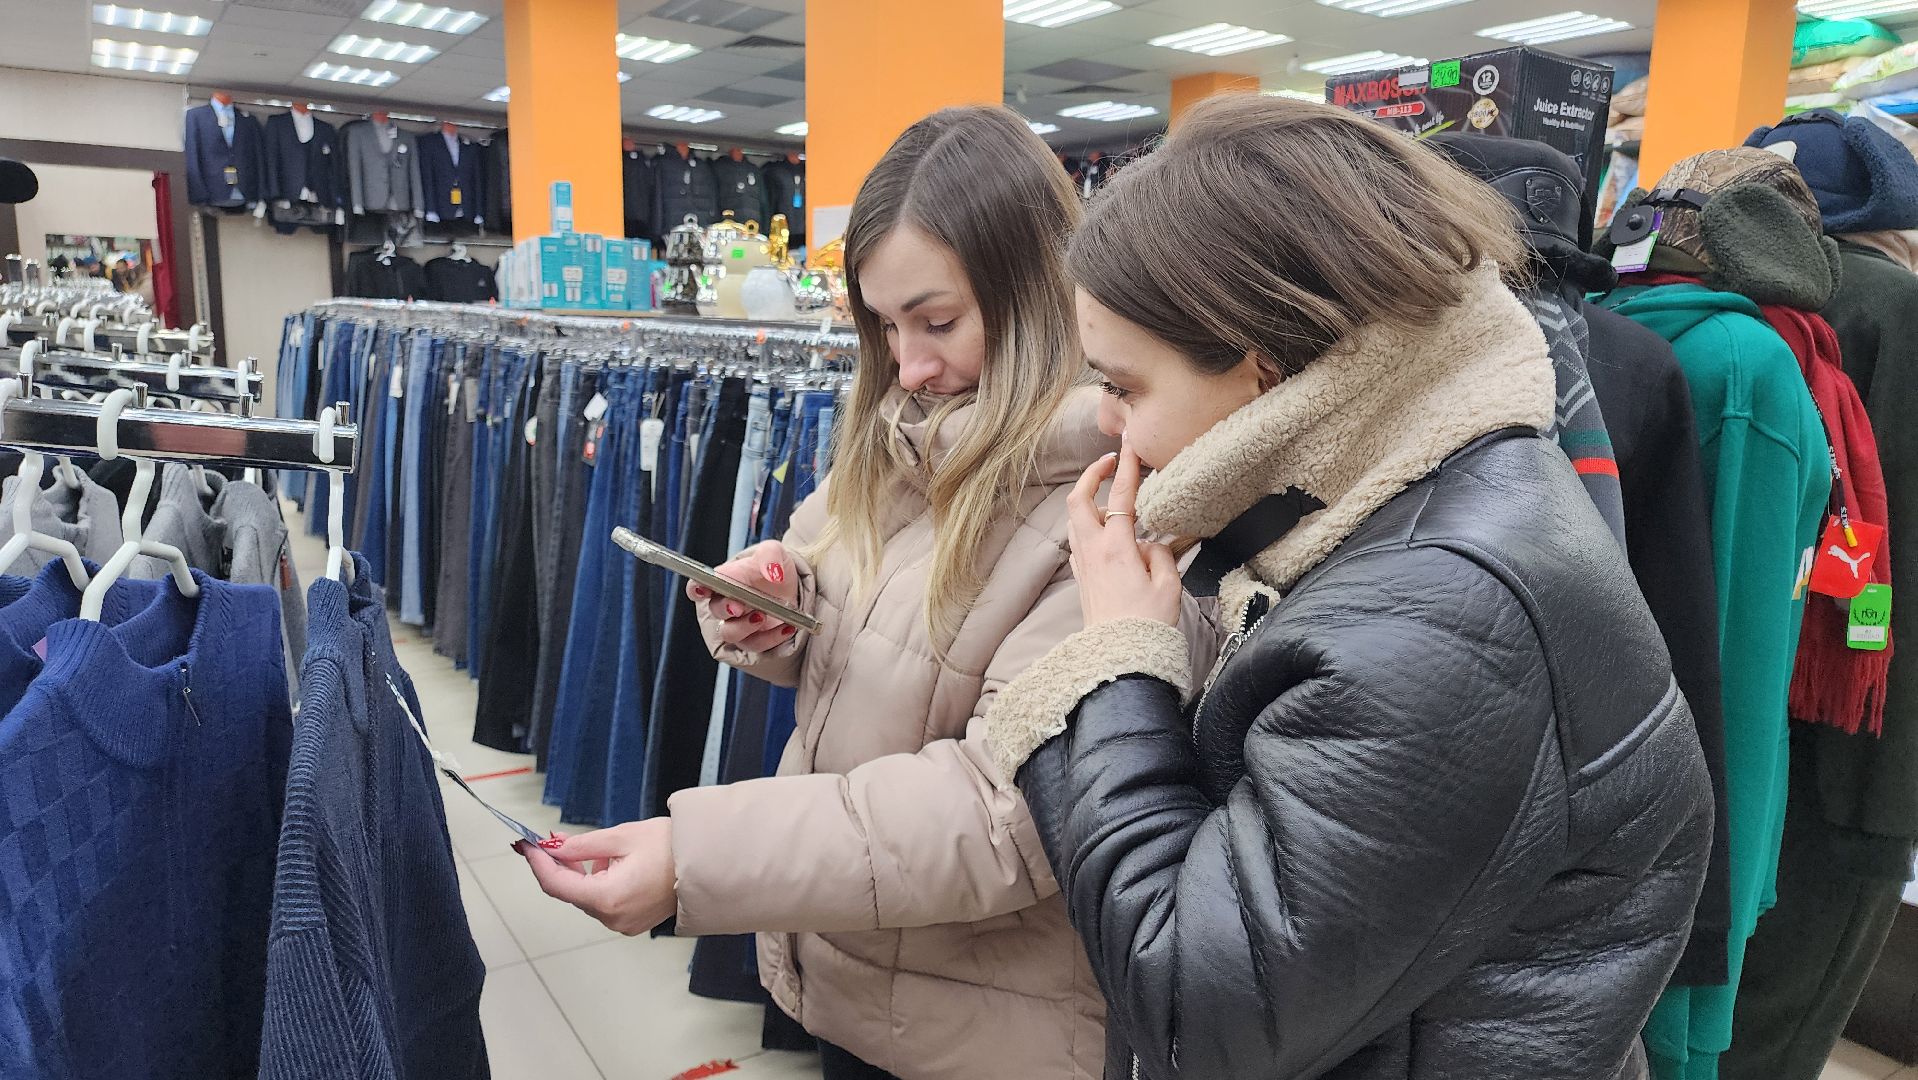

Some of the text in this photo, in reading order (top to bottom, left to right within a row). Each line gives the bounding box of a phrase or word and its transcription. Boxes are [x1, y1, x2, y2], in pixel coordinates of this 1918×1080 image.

[1481, 71, 1492, 83] 12
[1533, 97, 1595, 121] Juice Extractor
